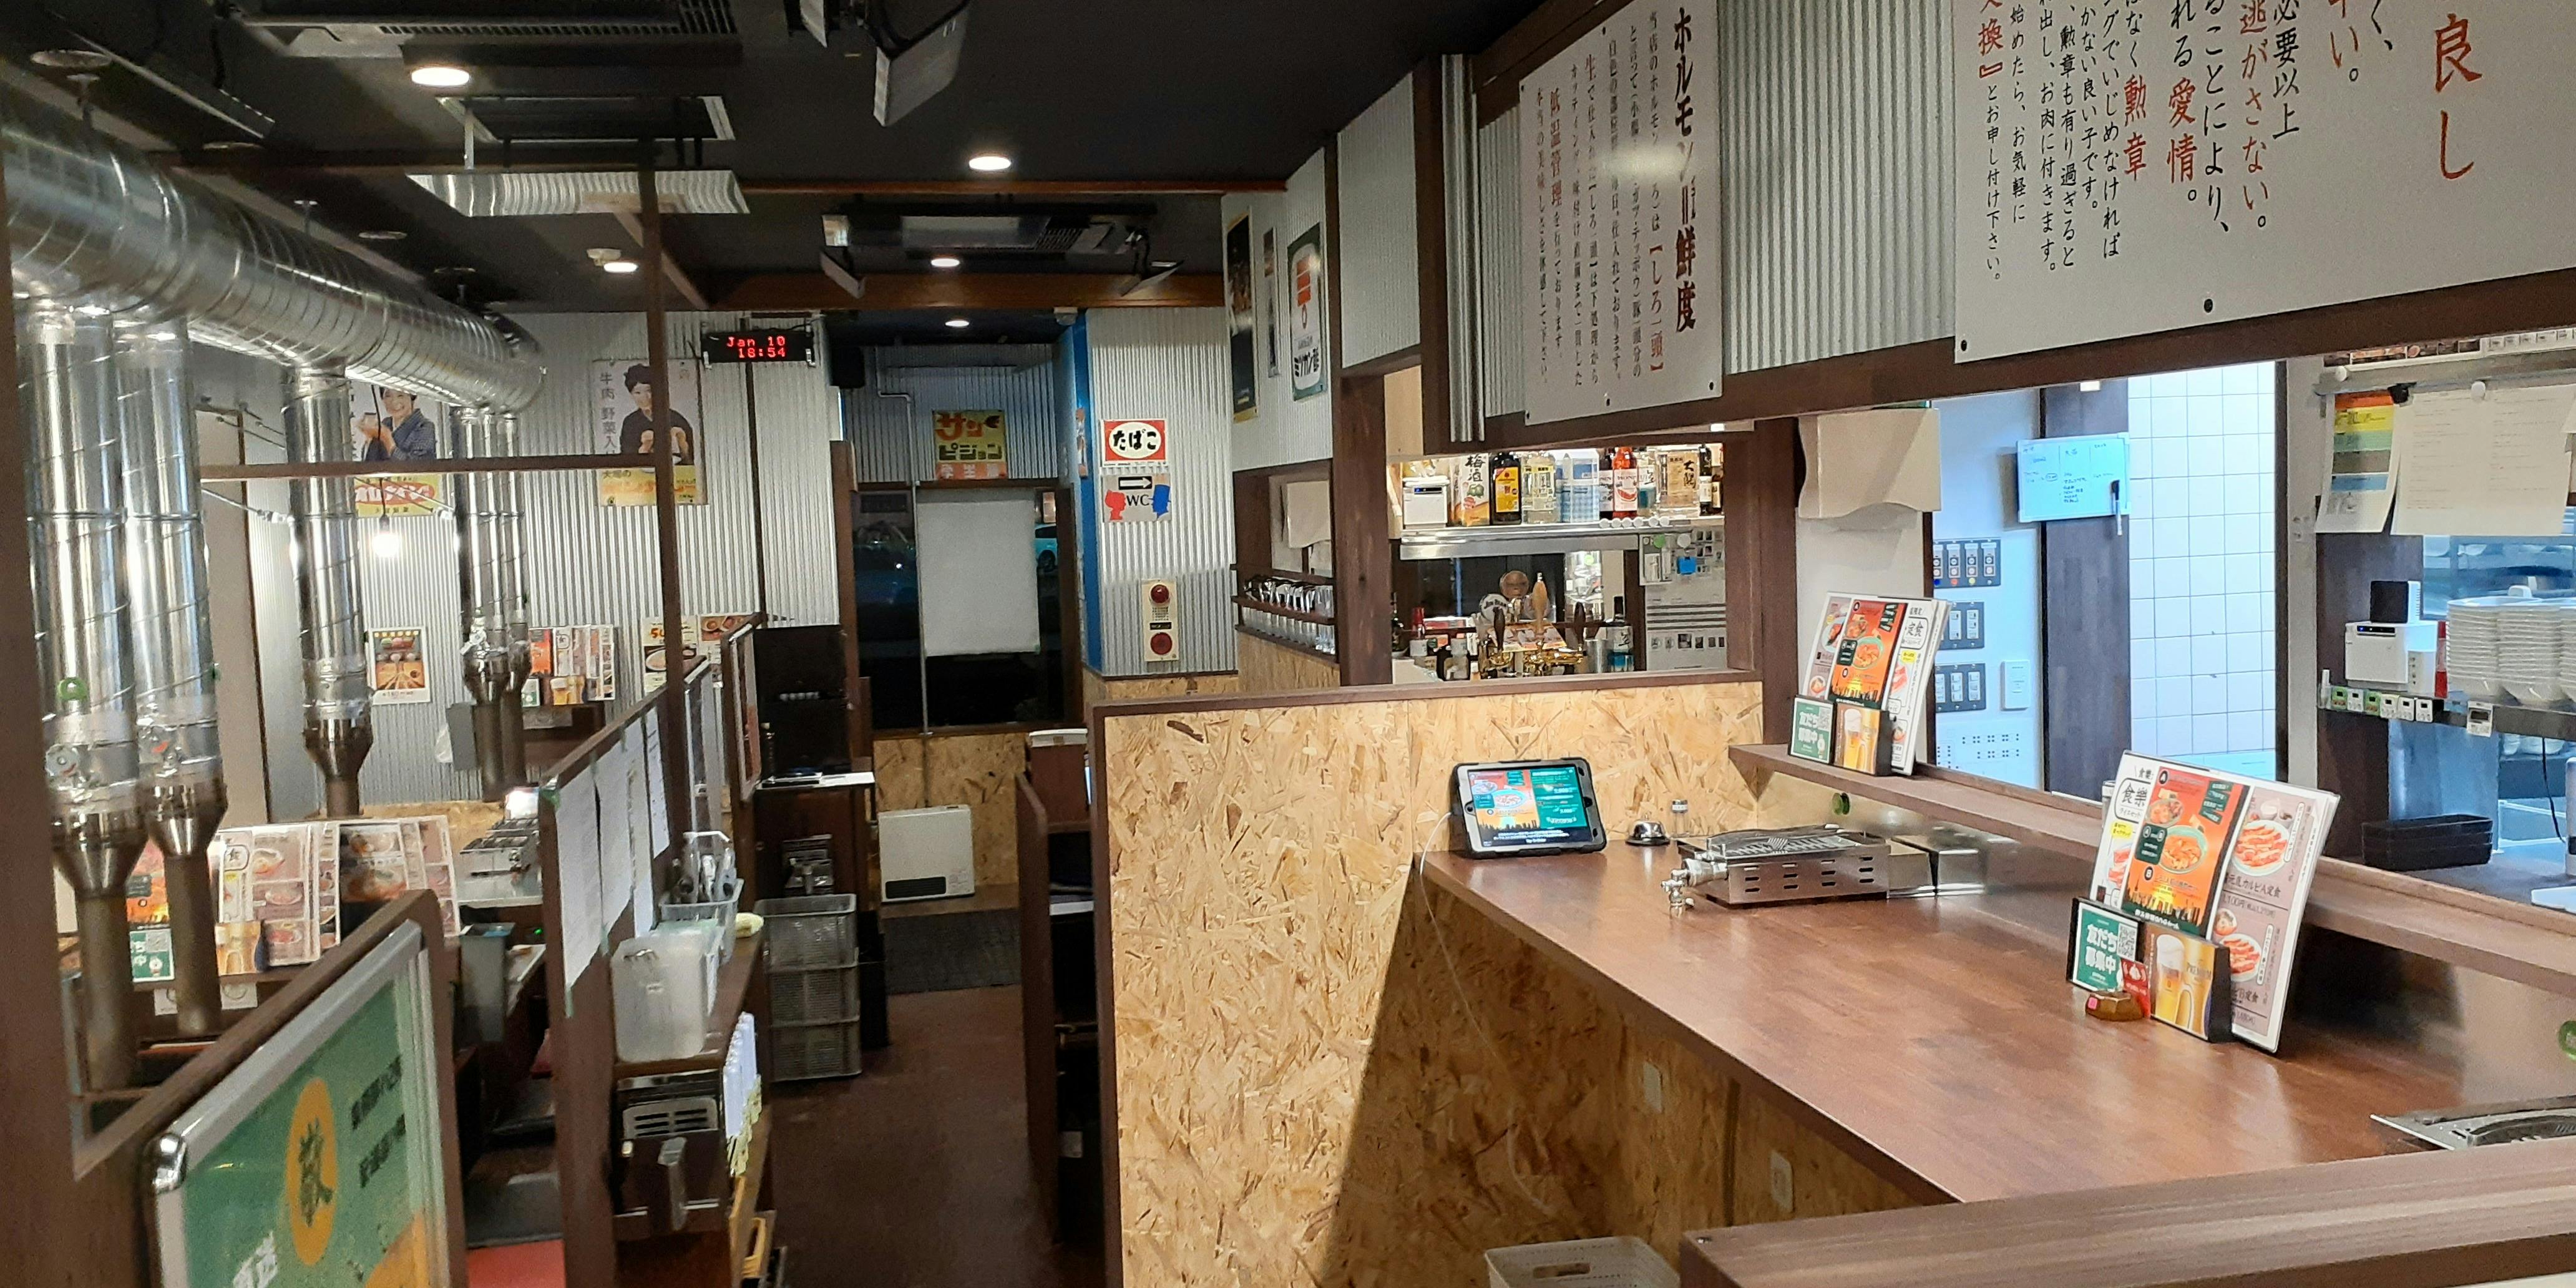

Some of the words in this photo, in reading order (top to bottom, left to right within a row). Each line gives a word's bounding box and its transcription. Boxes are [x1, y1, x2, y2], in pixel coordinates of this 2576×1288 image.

[726, 336, 755, 347] Jan
[768, 336, 786, 346] 10
[738, 347, 786, 359] 18:54
[1113, 429, 1157, 451] たばこ
[1465, 454, 1486, 482] 梅酒
[1126, 495, 1150, 507] WC
